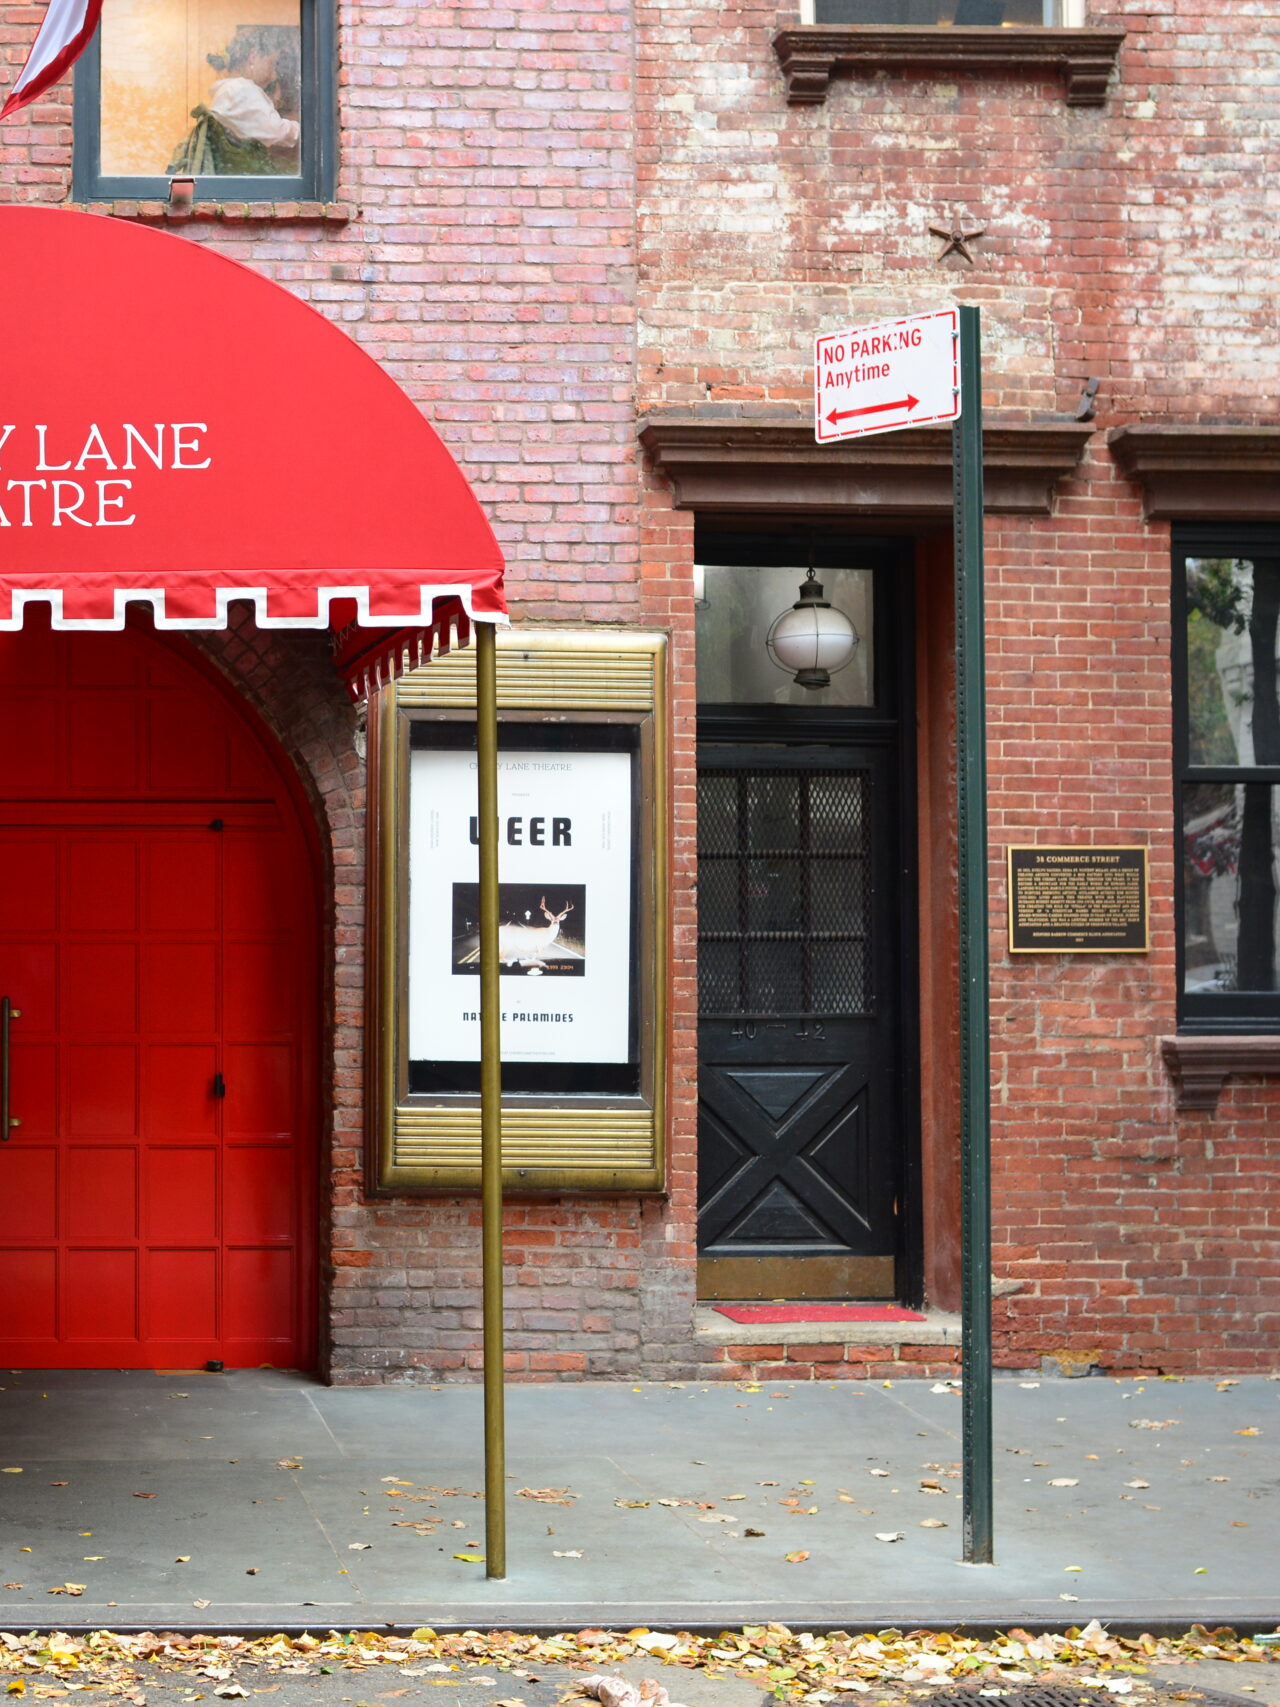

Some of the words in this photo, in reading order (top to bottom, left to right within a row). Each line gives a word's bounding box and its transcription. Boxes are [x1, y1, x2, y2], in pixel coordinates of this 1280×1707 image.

[824, 344, 845, 365] NO
[825, 363, 890, 389] Anytime
[35, 422, 212, 471] LANE
[506, 763, 530, 771] LANE
[532, 763, 572, 771] THEATRE
[513, 1012, 574, 1023] PALAMIDES
